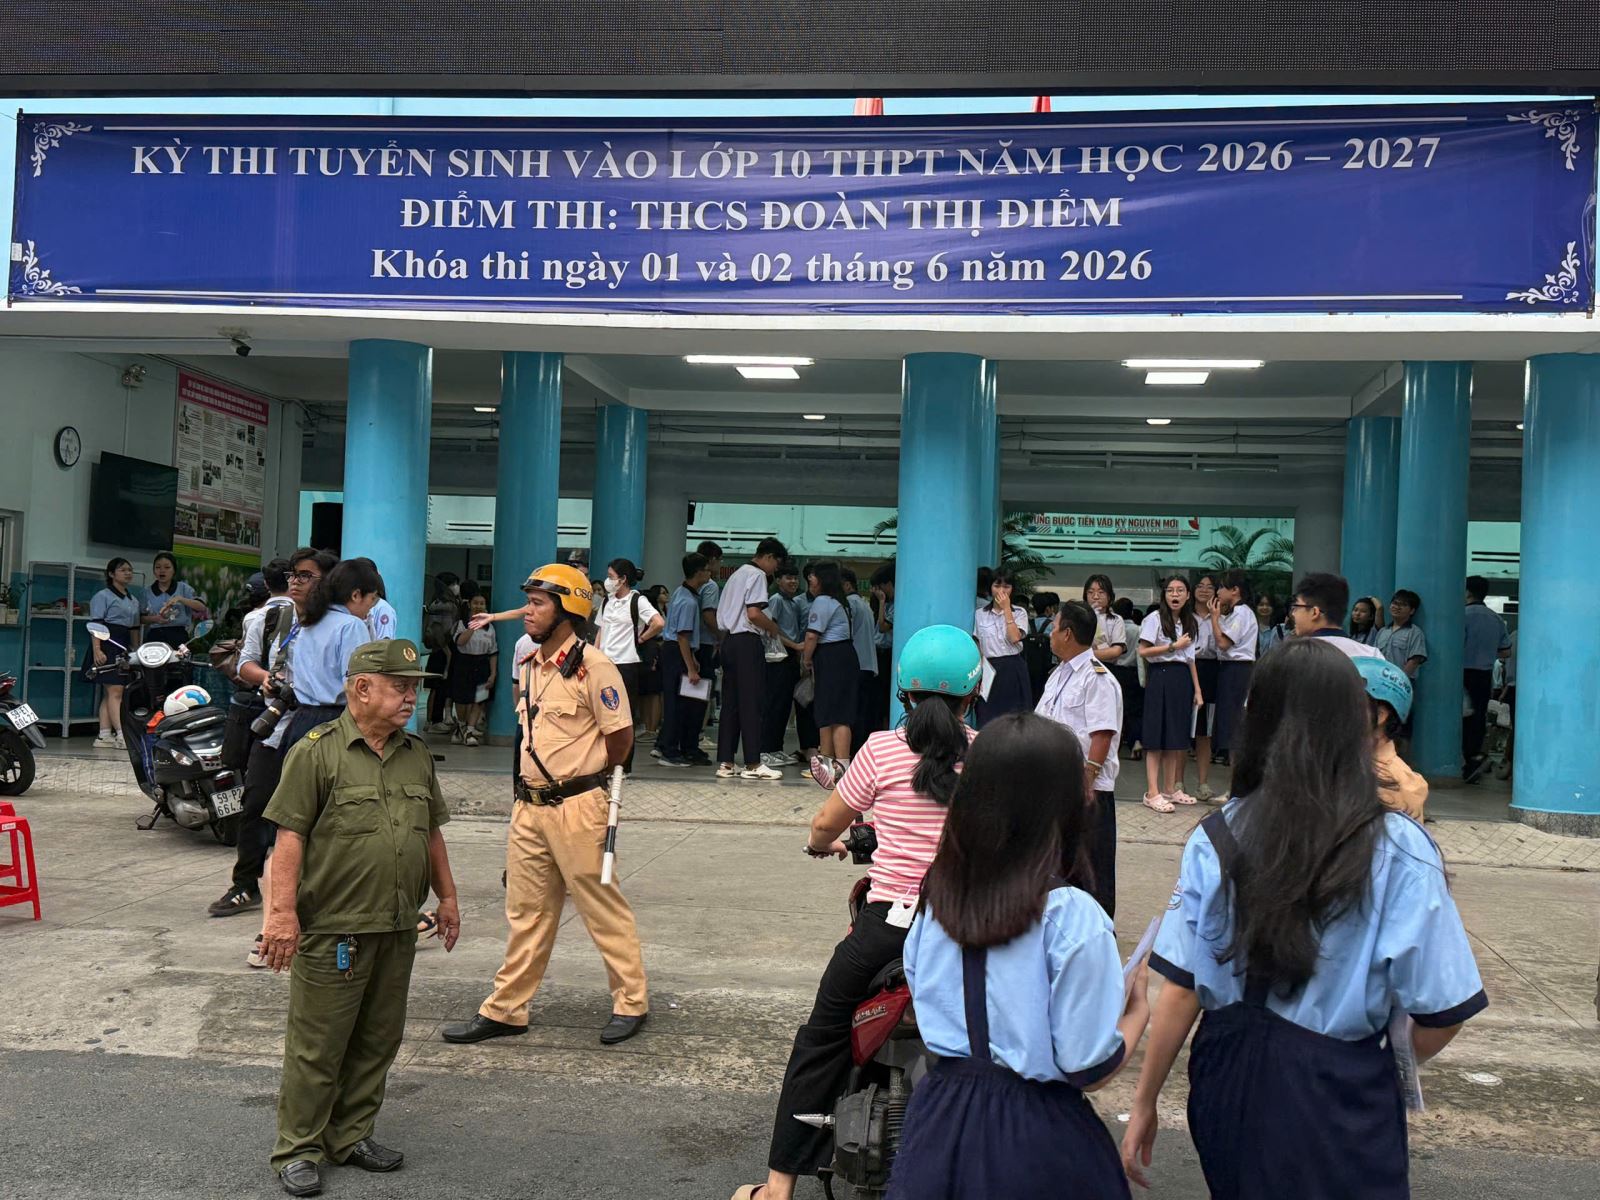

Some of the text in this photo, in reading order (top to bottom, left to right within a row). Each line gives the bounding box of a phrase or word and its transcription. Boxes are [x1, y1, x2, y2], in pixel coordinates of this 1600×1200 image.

[132, 138, 190, 174] KỲ
[204, 147, 276, 174] THI
[290, 139, 433, 177] TUYỂN
[447, 149, 550, 178] SINH
[564, 141, 656, 179] VÀO
[669, 141, 758, 179] LỚP
[772, 151, 812, 179] 10
[824, 148, 945, 178] THPT
[957, 140, 1063, 176] NĂM
[1078, 144, 1183, 182] HỌC
[1198, 141, 1293, 172] 2026
[1343, 137, 1441, 169] 2027
[401, 187, 1122, 236] ĐIỂM THI: THCS ĐOÀN THỊ ĐIỂM
[372, 249, 1152, 291] Khóa thi ngày 01 và 02 tháng 6 năm 2026
